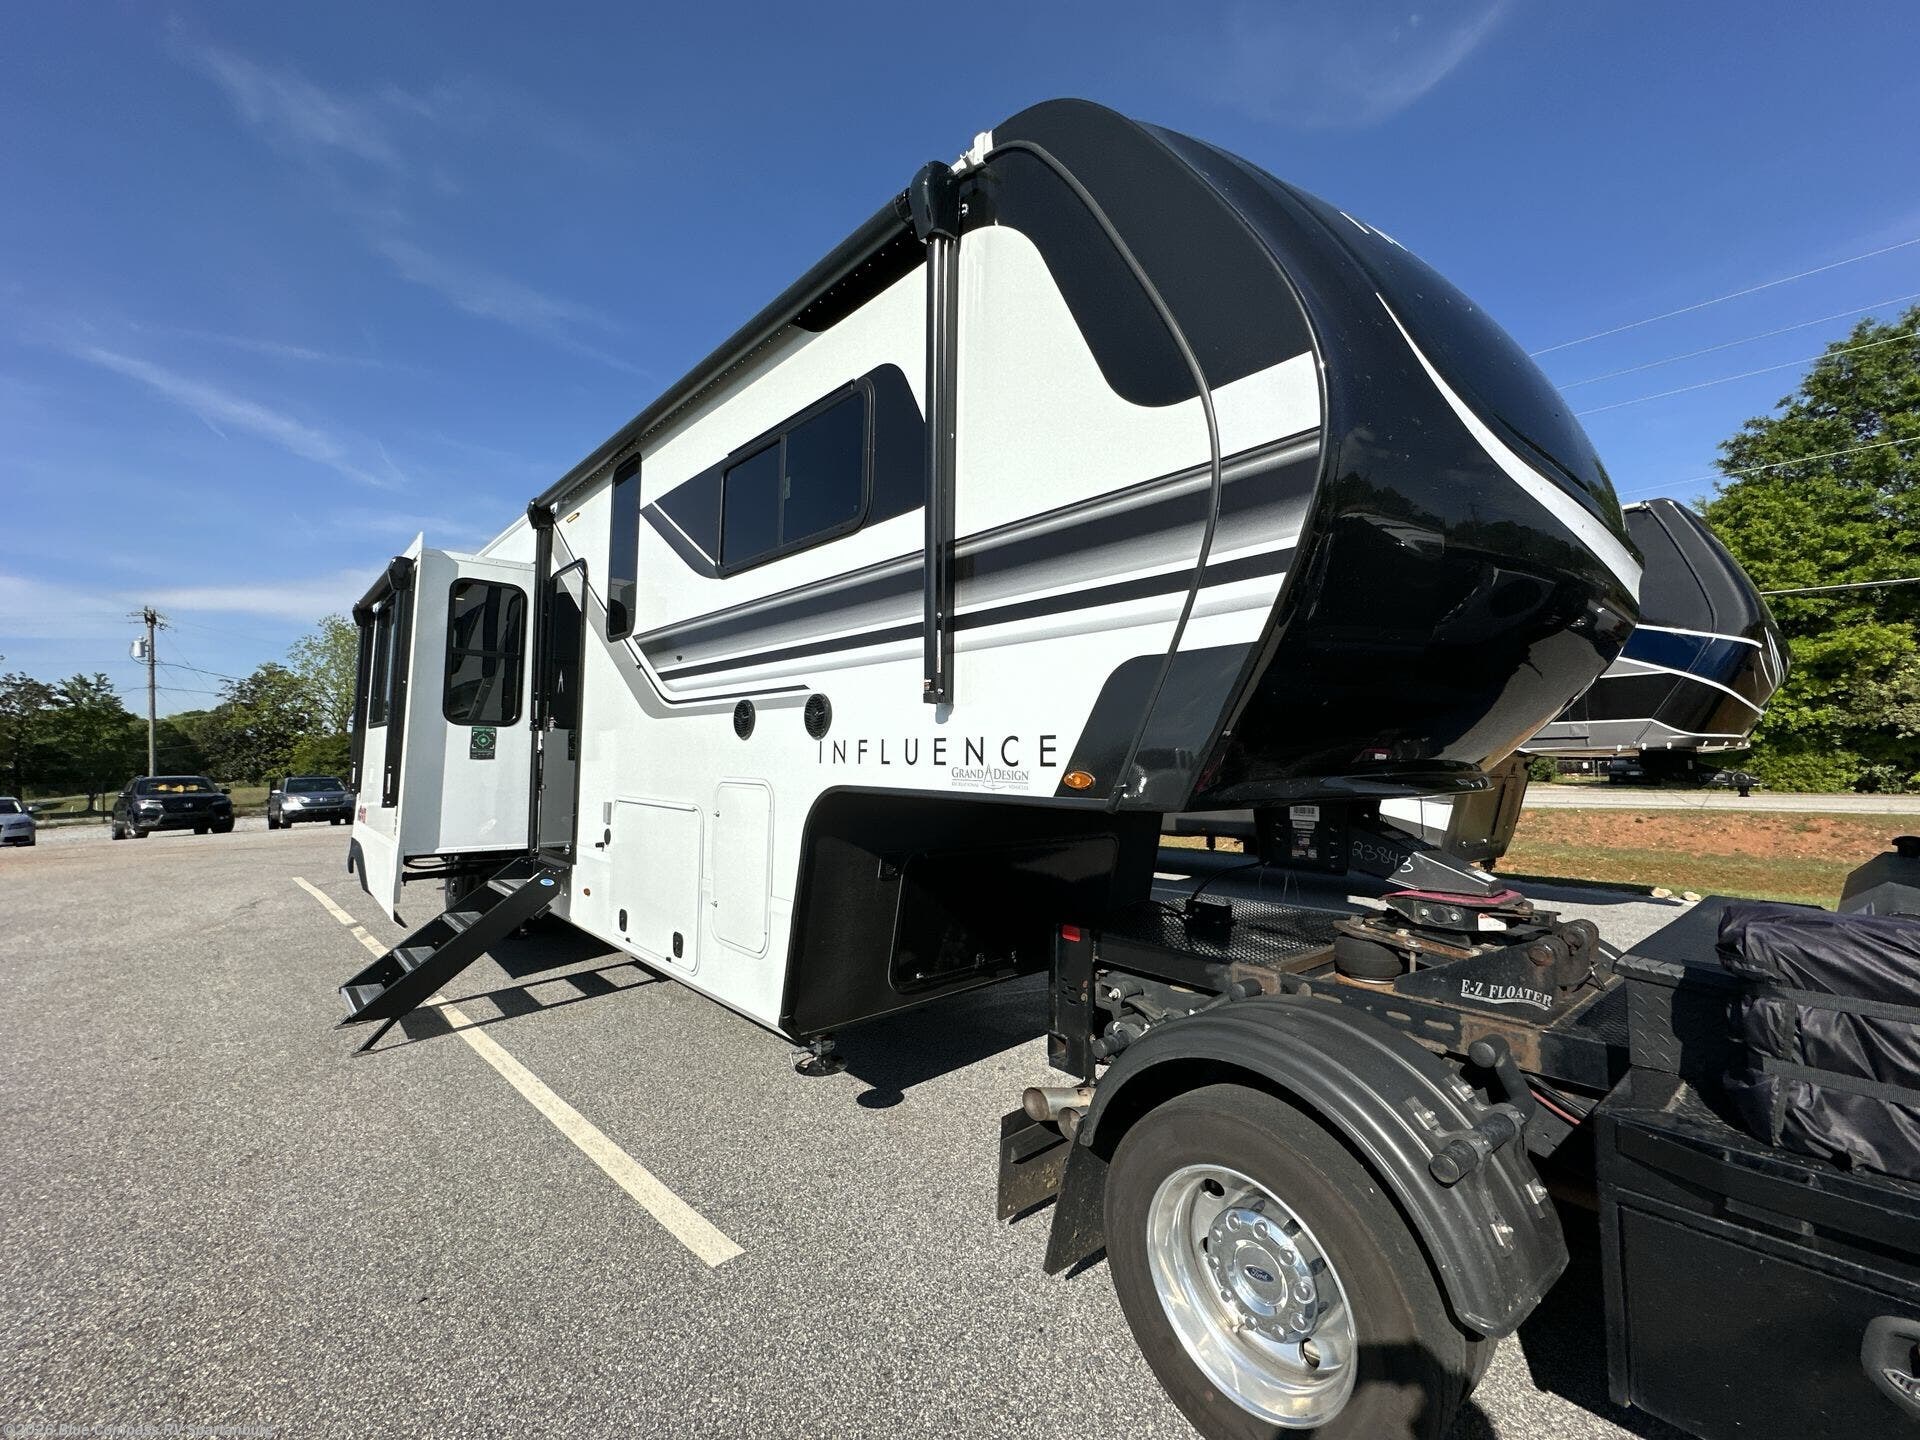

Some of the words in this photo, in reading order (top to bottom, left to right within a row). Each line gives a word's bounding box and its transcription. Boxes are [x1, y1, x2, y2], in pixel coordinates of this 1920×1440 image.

[818, 734, 1057, 767] INFLUENCE
[951, 766, 984, 779] GRAND
[993, 768, 1029, 781] DESIGN
[1461, 979, 1484, 996] E-Z
[1488, 984, 1553, 1007] FLOATER
